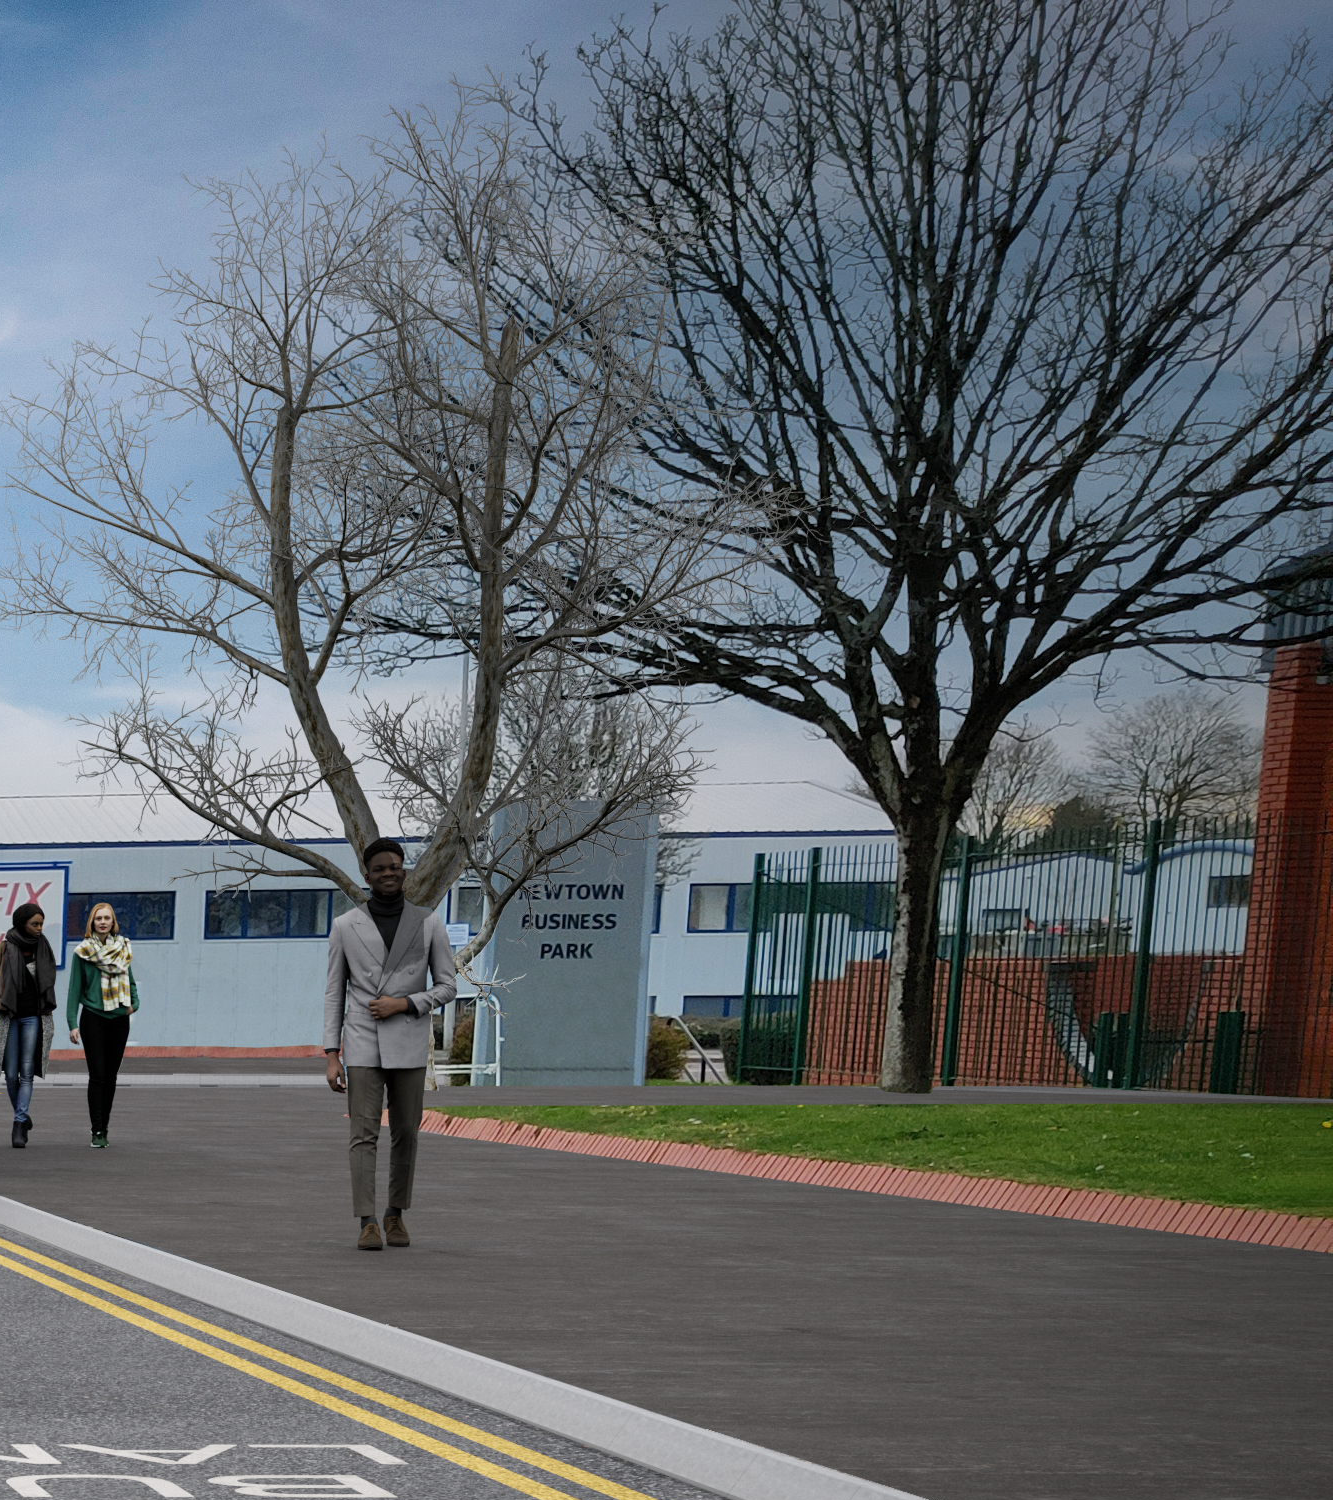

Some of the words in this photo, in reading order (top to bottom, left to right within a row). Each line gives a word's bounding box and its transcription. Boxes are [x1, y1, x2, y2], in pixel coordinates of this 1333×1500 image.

[518, 884, 625, 900] NEWTOWN
[521, 913, 617, 930] BUSINESS
[539, 943, 594, 960] PARK
